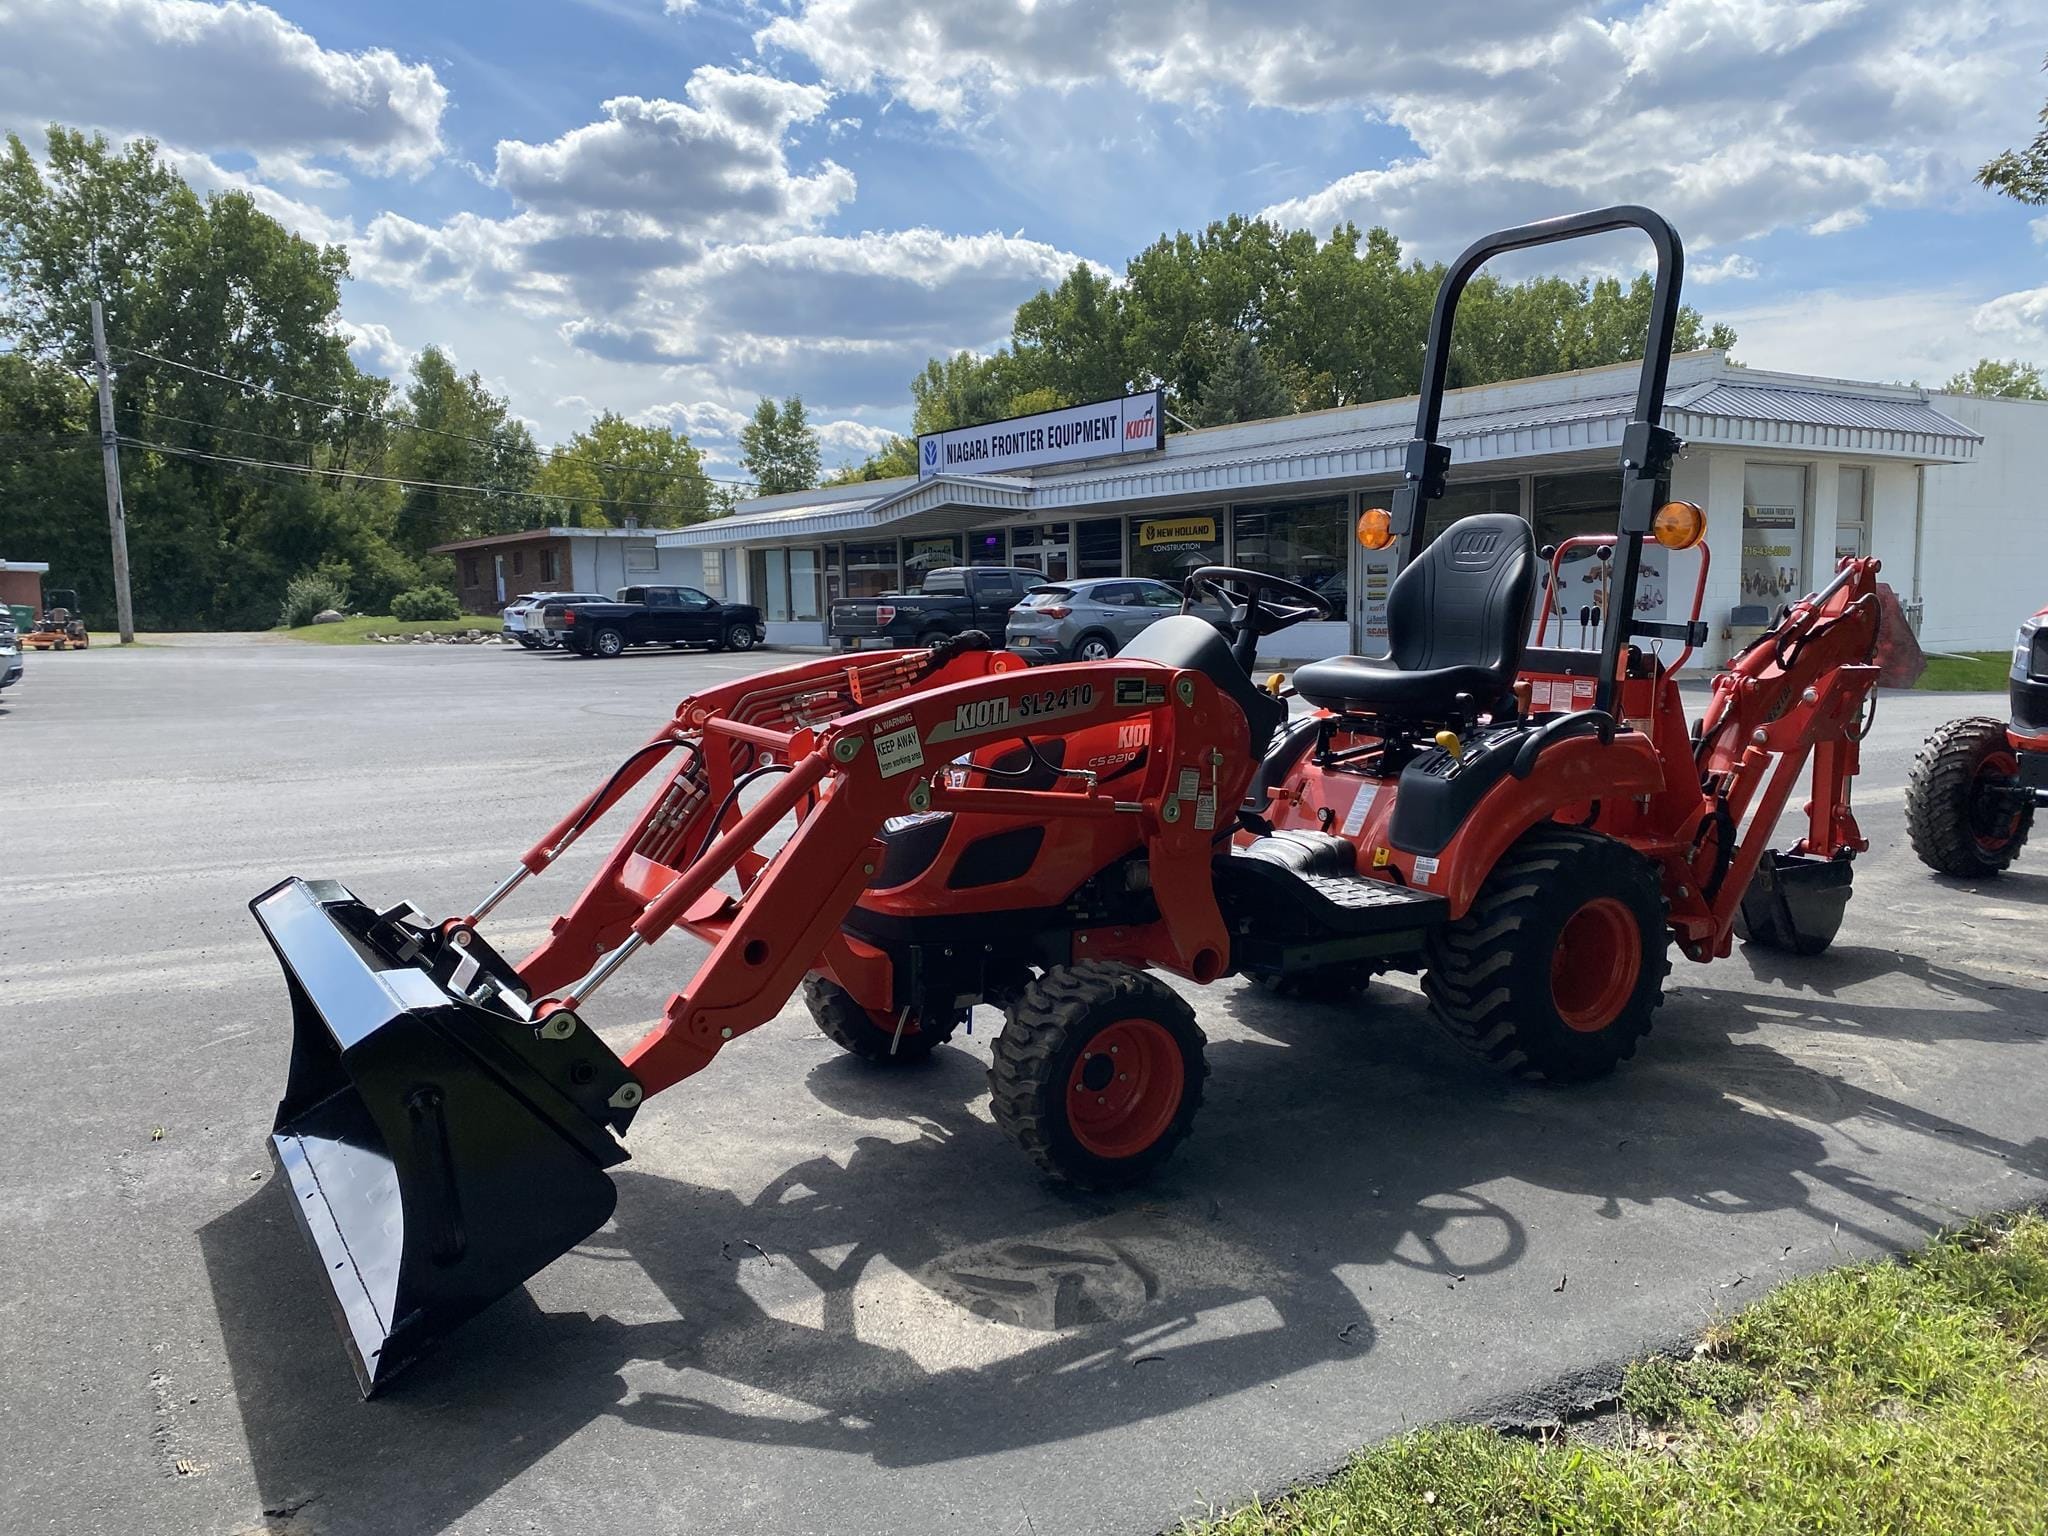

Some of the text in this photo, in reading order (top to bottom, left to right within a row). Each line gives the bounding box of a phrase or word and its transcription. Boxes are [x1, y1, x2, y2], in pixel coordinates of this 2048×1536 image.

[1125, 417, 1155, 440] KIOTI
[946, 415, 1117, 465] NIAGARA FRONTIER EQUIPMENT
[1156, 525, 1209, 538] NEW HOLLAND
[1152, 542, 1201, 552] CONSTRUCTION
[954, 697, 1009, 732] KIOTI
[1018, 684, 1093, 717] SL2410
[882, 712, 913, 730] WARNING
[876, 731, 917, 756] KEEP AWAY
[1118, 724, 1150, 750] KIOT
[881, 751, 922, 771] from working area
[1088, 752, 1136, 768] CS2210
